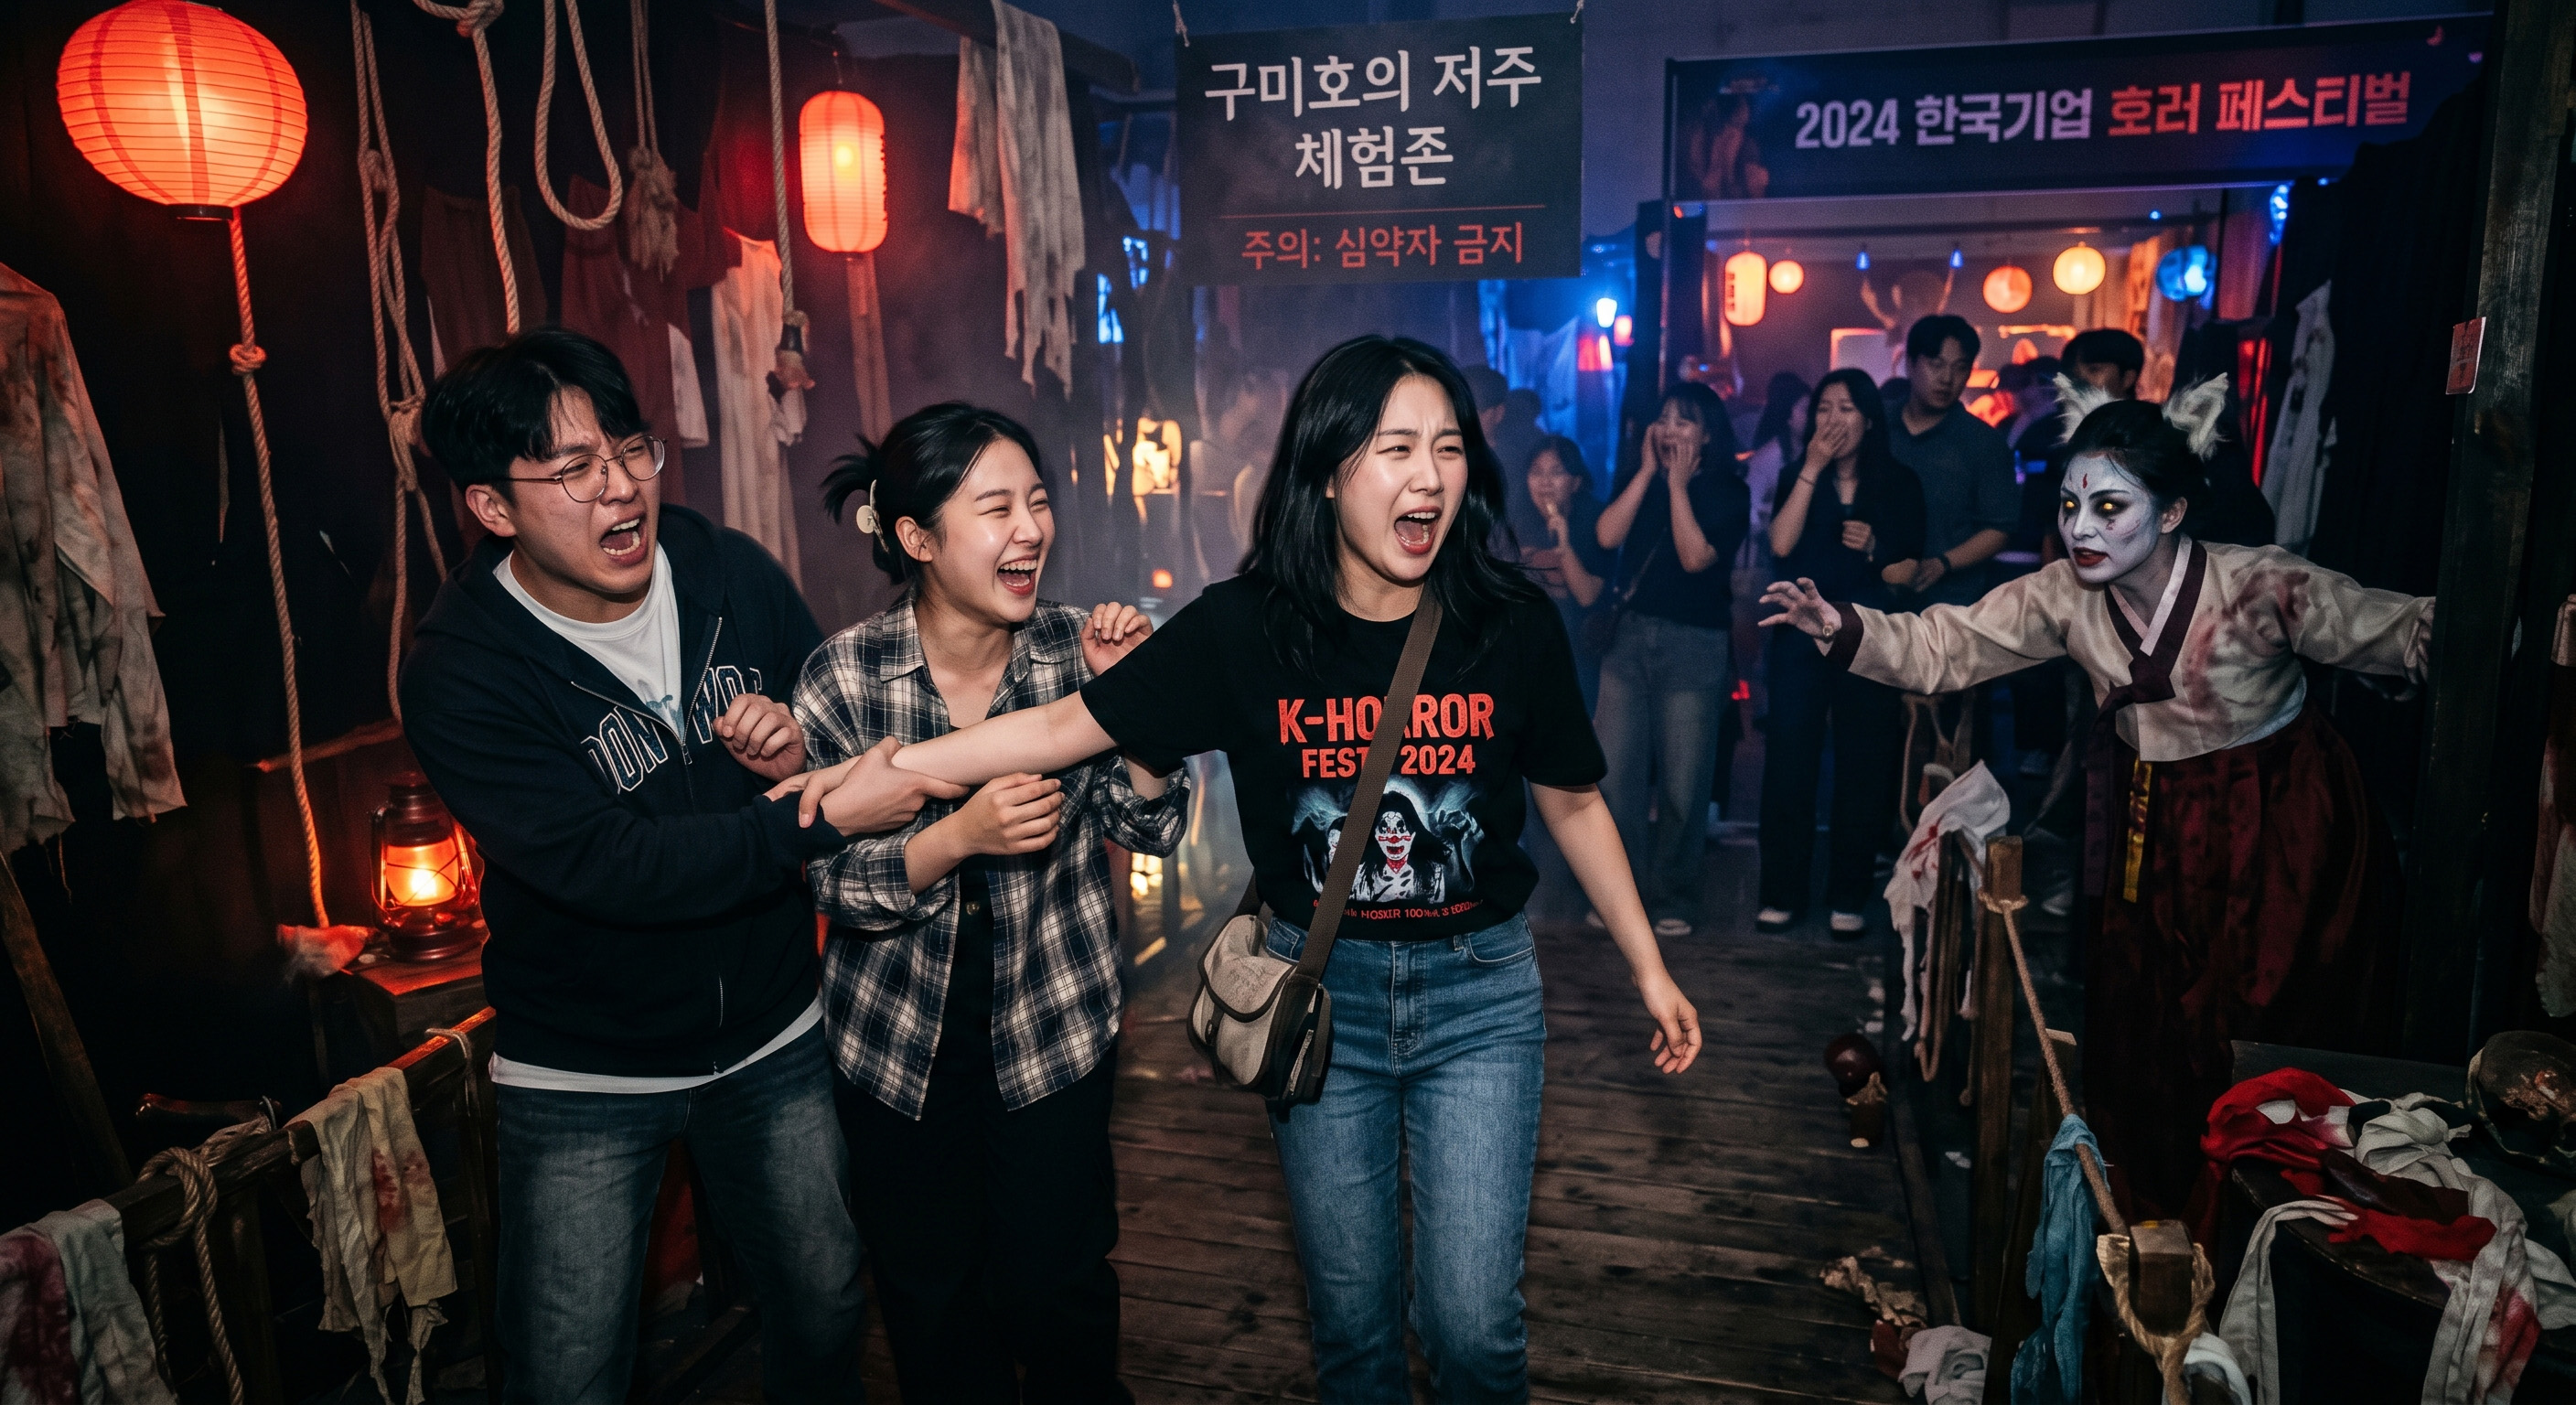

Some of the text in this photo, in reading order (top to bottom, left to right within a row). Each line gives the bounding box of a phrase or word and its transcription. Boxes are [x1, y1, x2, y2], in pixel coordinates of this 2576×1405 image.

[1205, 46, 1542, 122] 구미호의 저주
[1795, 71, 2410, 149] 2024 한국기업 호러 페스티벌
[1294, 125, 1454, 189] 체험존
[1241, 221, 1522, 270] 주의: 심약자 금지
[1277, 692, 1495, 745] K-HOROR
[1400, 744, 1476, 775] 2024
